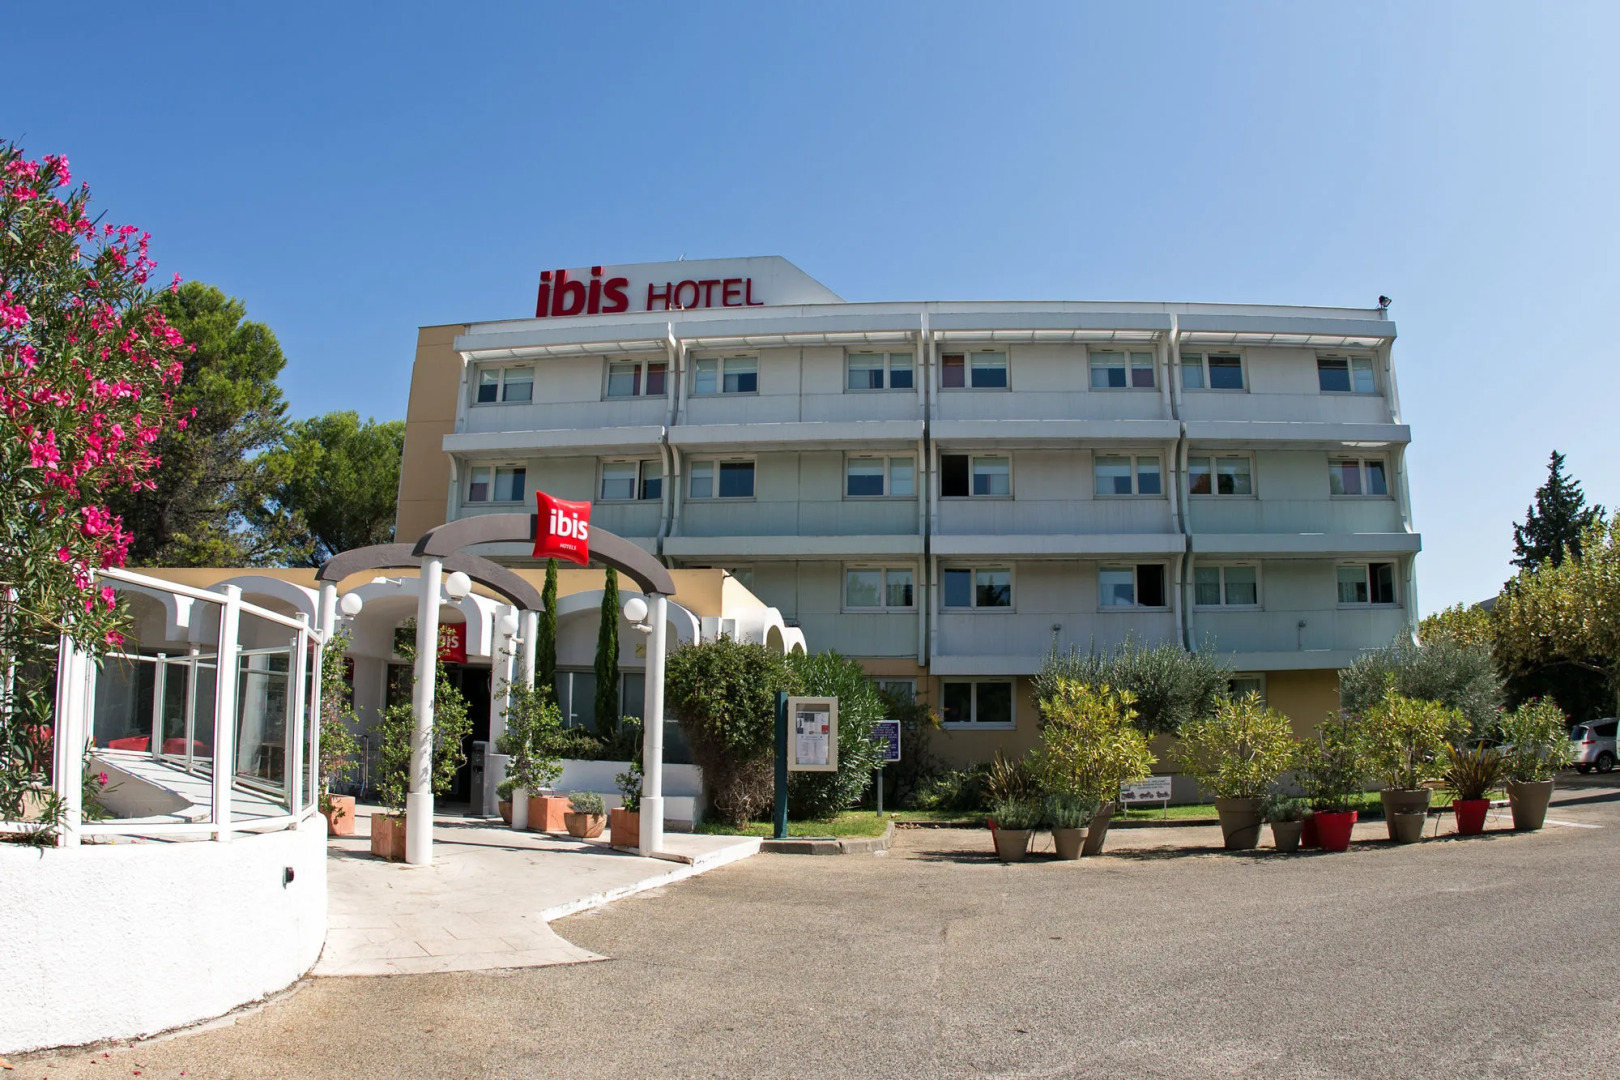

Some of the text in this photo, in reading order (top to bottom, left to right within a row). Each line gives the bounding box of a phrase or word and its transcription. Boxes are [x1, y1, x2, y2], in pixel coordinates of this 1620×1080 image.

[536, 266, 764, 317] ibis HOTEL
[549, 508, 588, 540] ibis
[560, 543, 577, 551] HOTELS
[437, 629, 459, 649] is
